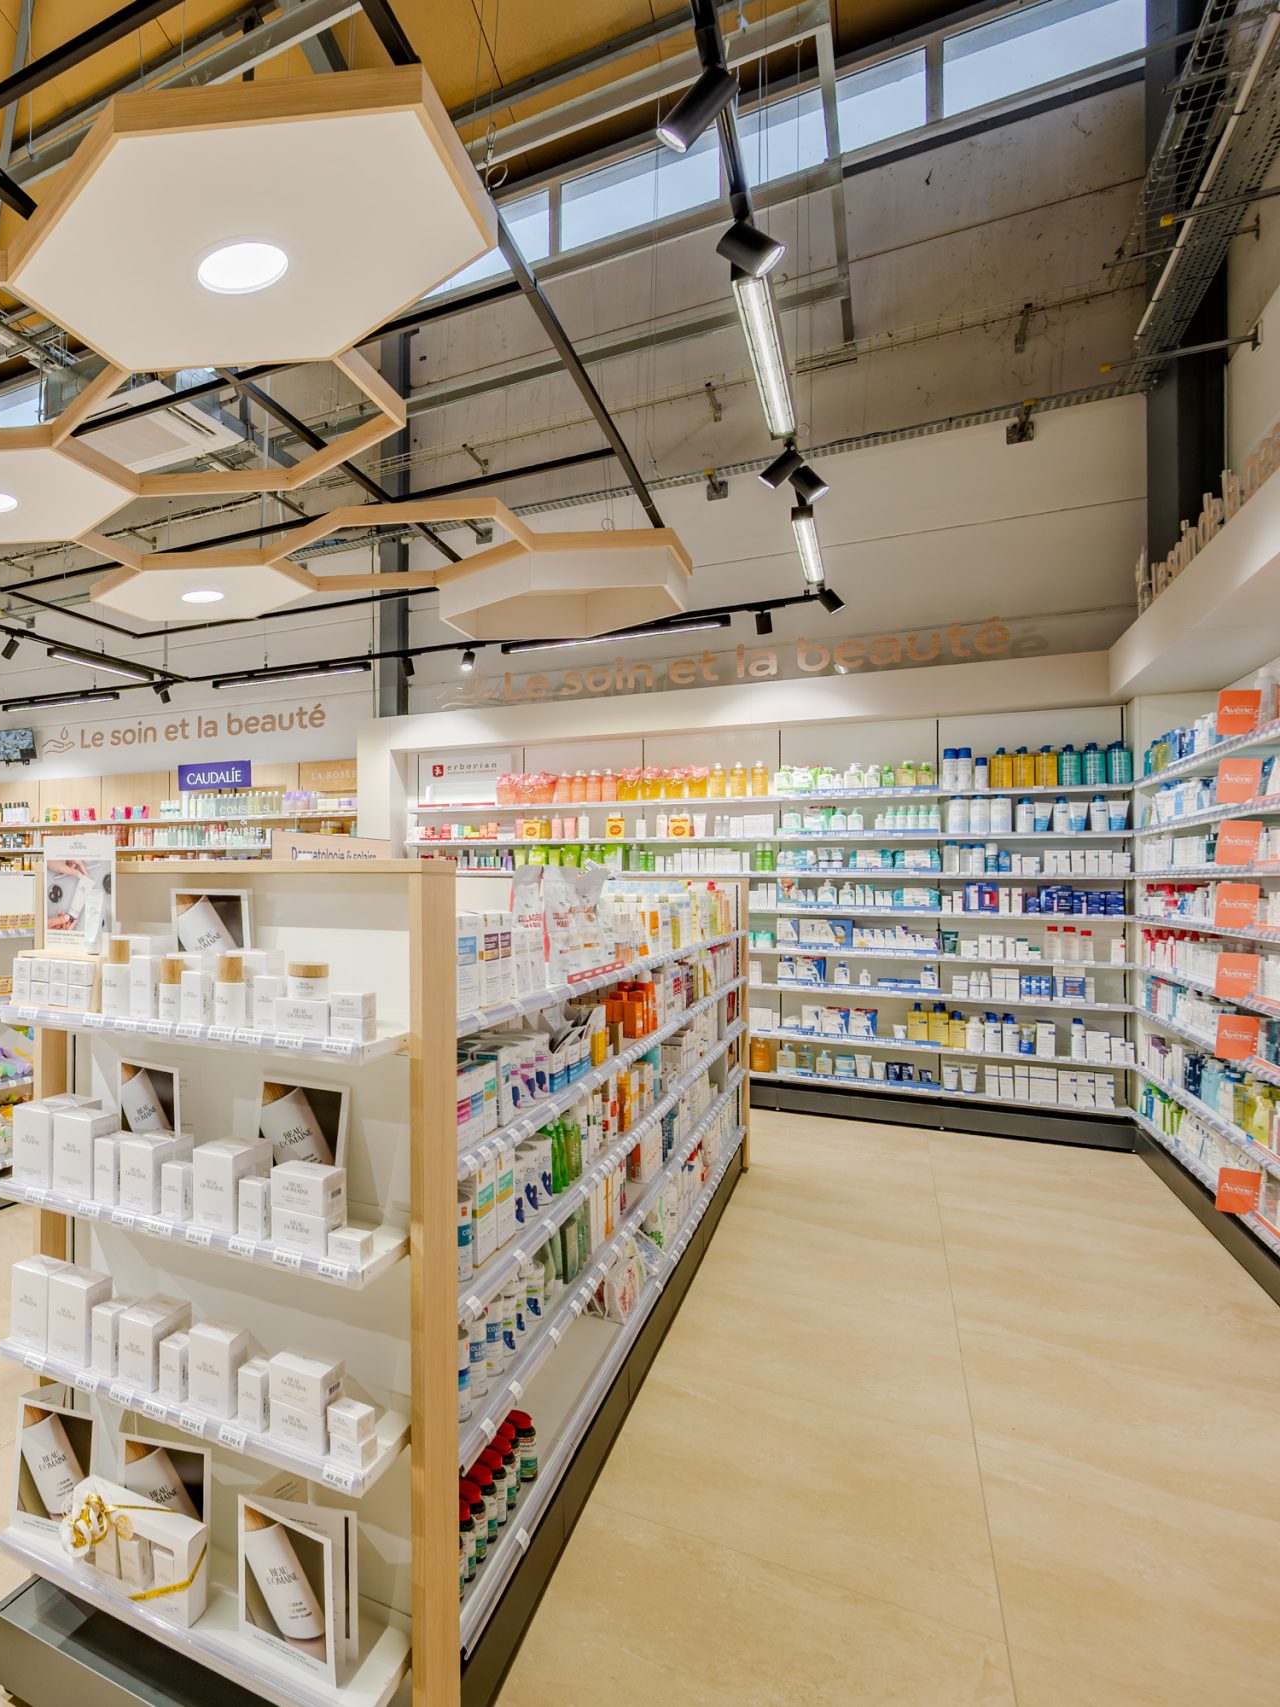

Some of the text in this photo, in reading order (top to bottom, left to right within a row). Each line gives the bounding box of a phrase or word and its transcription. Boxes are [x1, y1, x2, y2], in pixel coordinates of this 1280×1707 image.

[503, 616, 1012, 702] Le soin et la beauté
[81, 704, 327, 749] Le soin et la beauté
[220, 804, 270, 815] CONSEILS
[279, 1128, 313, 1149] DOMAINE
[283, 1126, 303, 1138] BEAU
[38, 1453, 68, 1472] DOMAINE
[42, 1450, 59, 1463] BEAU
[149, 1484, 168, 1499] BEAU
[266, 1571, 300, 1585] DOMAINE
[269, 1565, 288, 1578] BEAU
